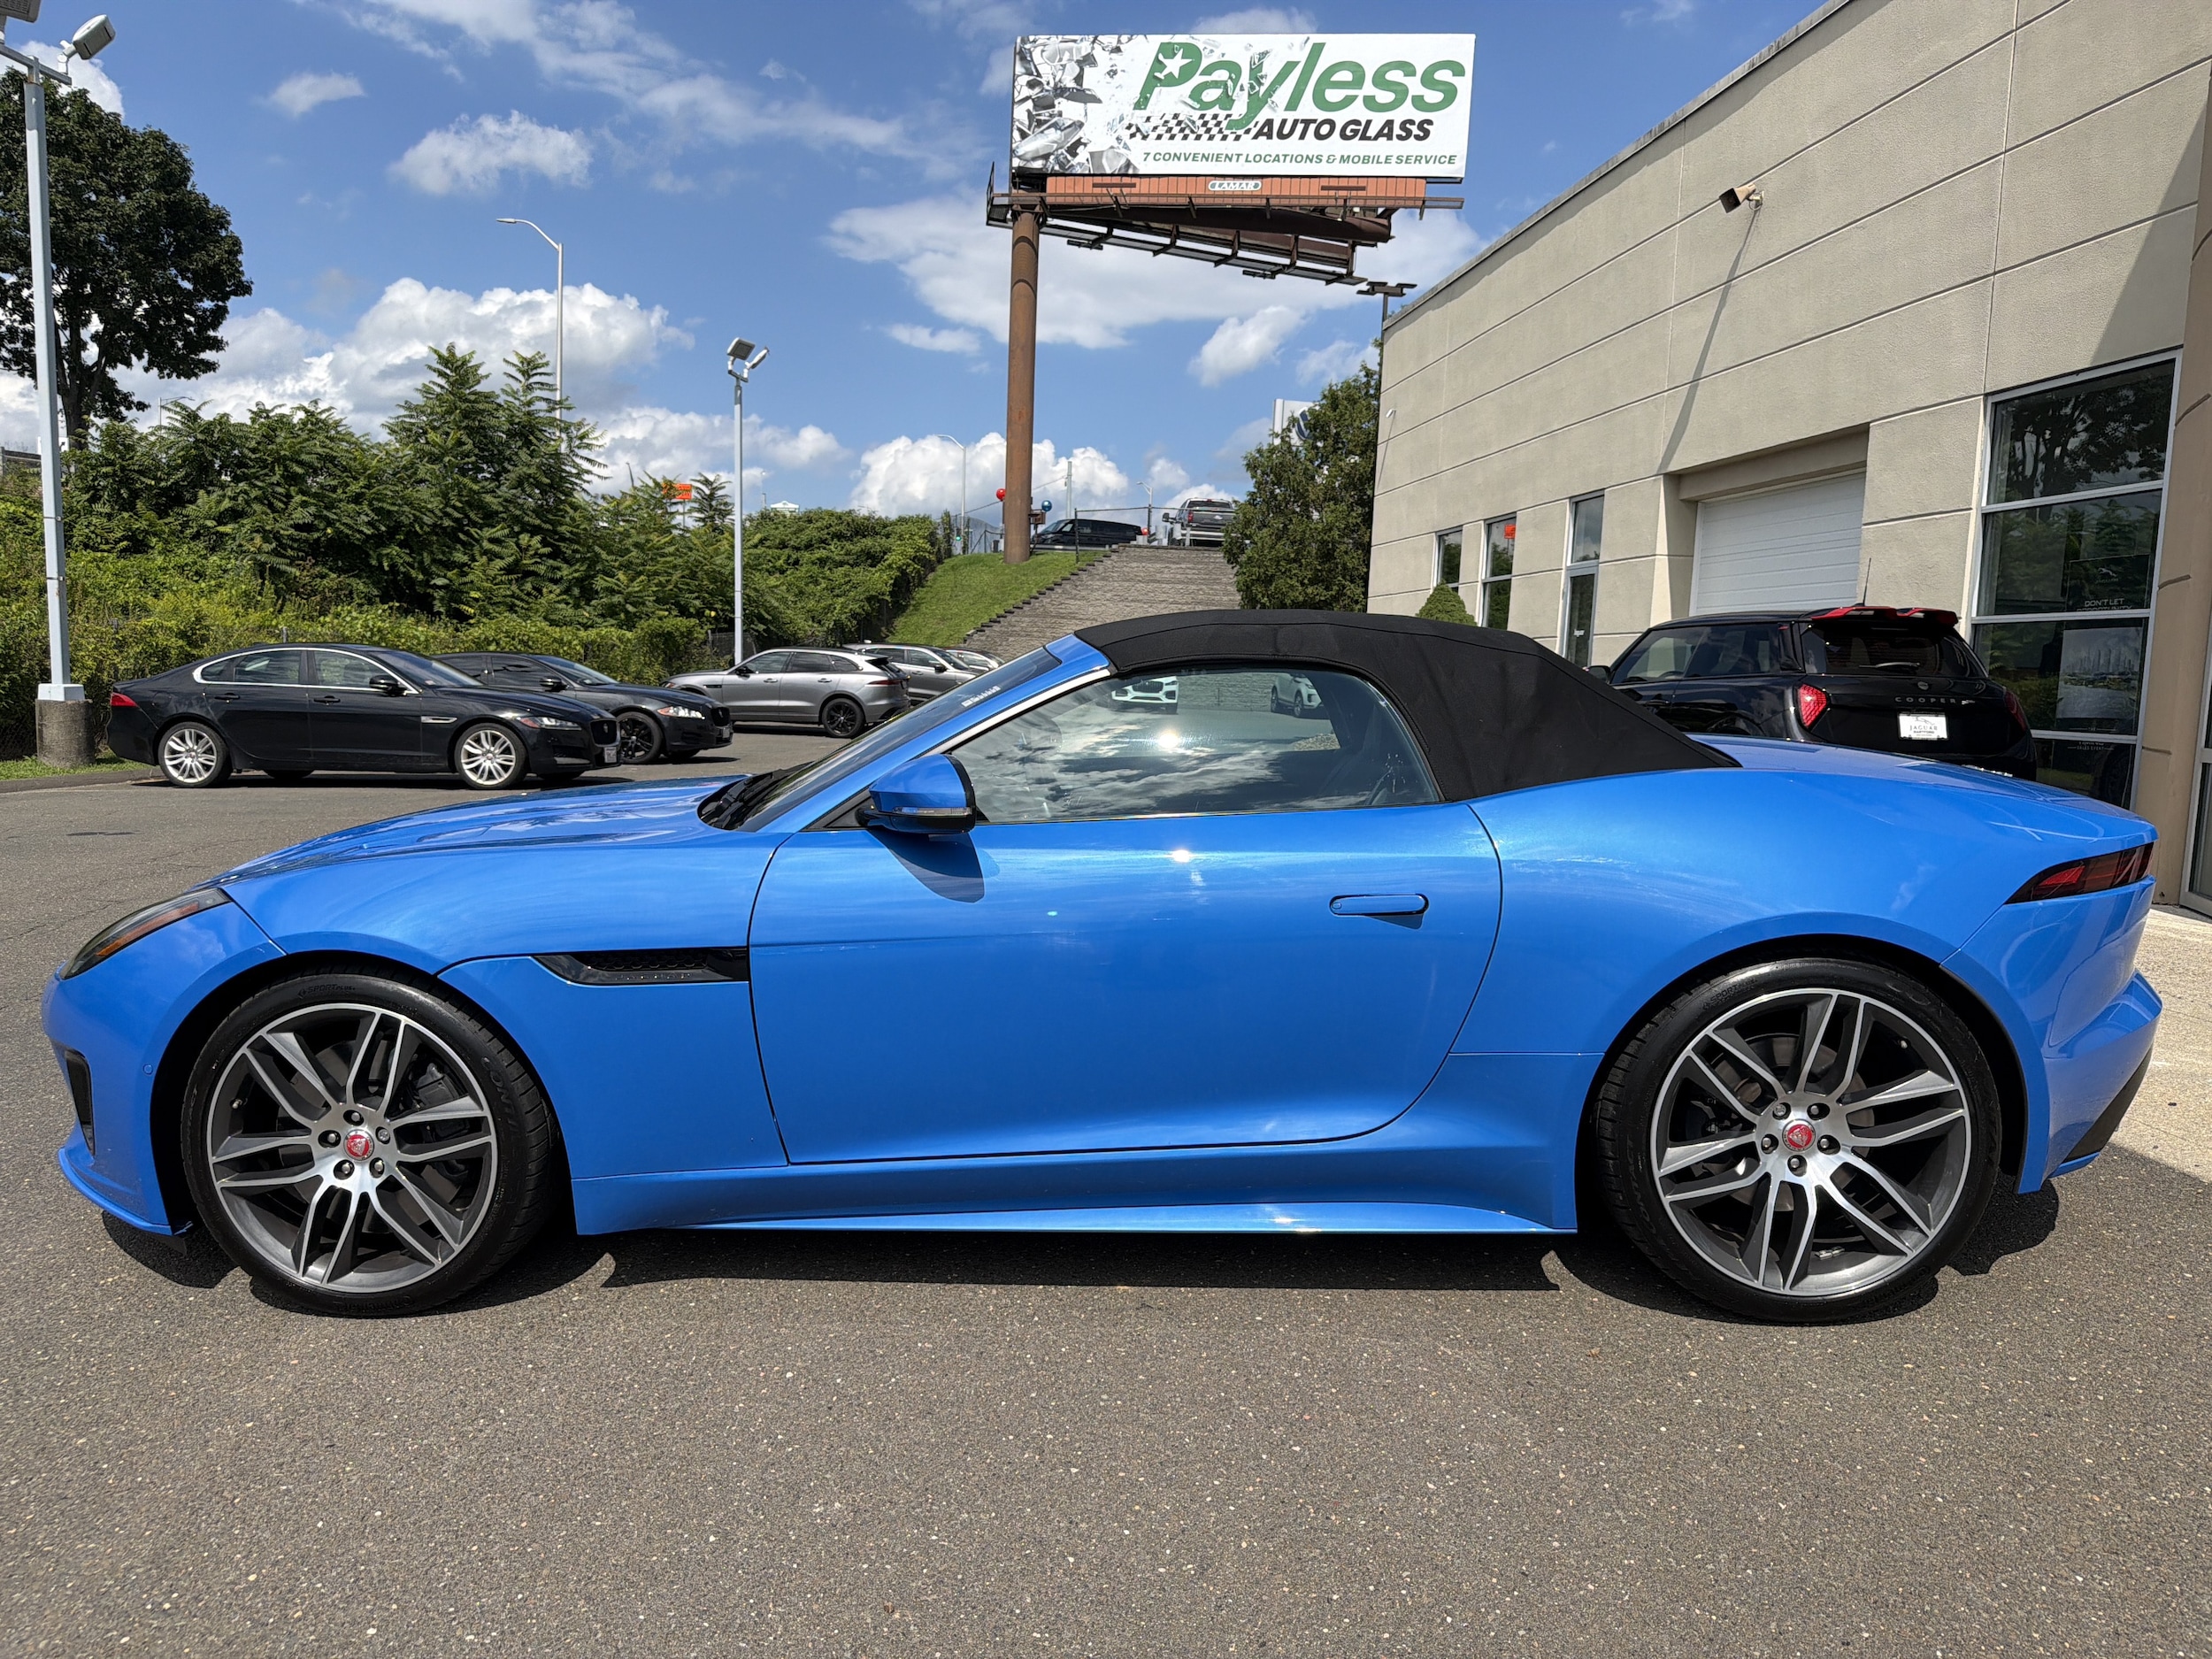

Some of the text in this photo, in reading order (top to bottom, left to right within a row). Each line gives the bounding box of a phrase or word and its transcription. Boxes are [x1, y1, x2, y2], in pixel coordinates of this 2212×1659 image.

[1133, 42, 1465, 130] Payless
[1252, 118, 1433, 141] AUTO GLASS
[1143, 152, 1457, 165] 7 CONVENIENT LOCATIONS & MOBILE SERVICE
[1214, 180, 1257, 190] LAMAR
